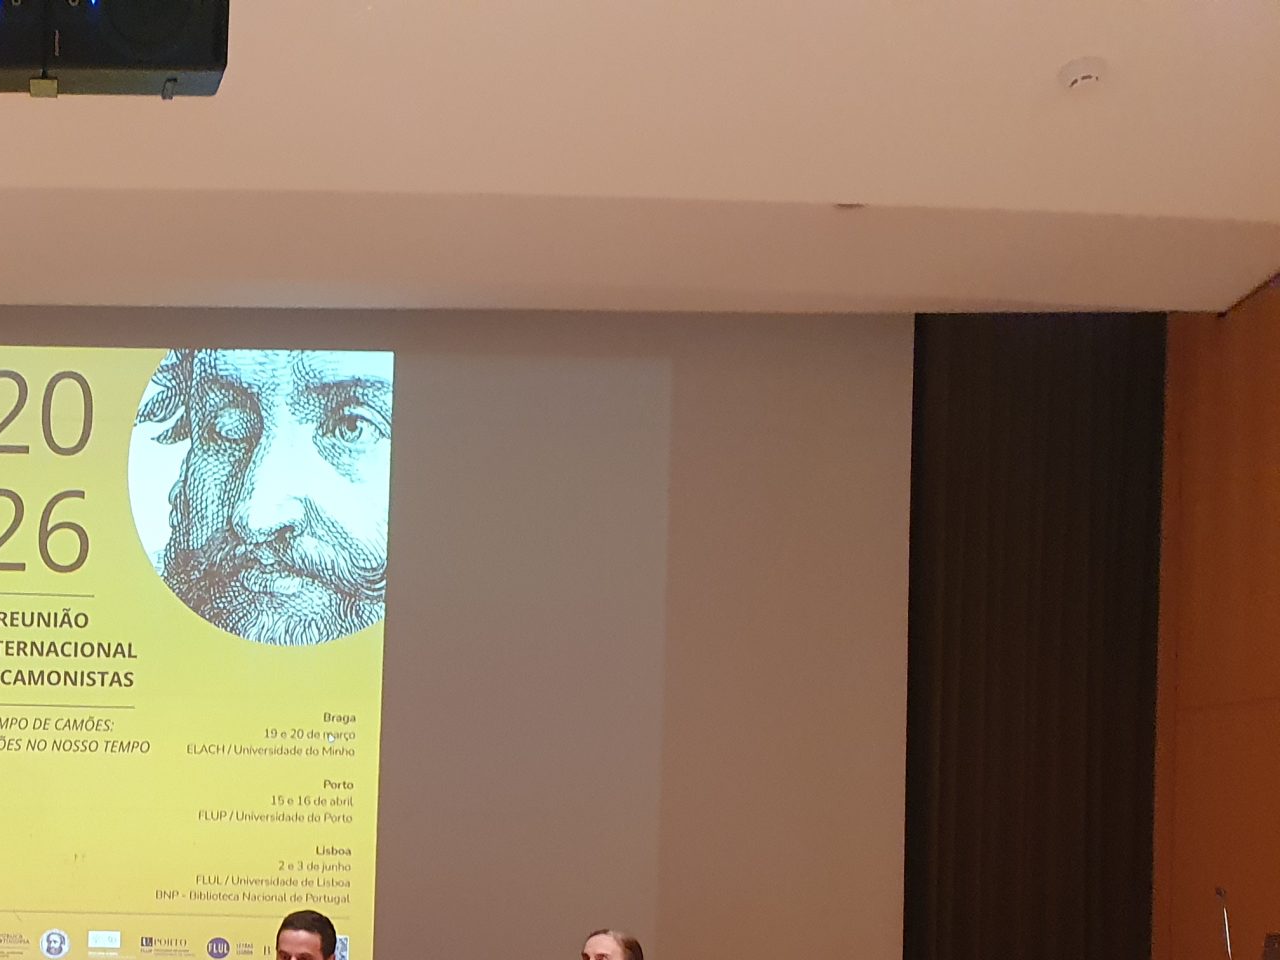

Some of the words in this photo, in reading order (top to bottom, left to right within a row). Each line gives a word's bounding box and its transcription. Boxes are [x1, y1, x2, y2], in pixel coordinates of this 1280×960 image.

[0, 669, 135, 688] CAMONISTAS
[32, 718, 51, 731] DE
[54, 716, 115, 733] CAMÕES:
[323, 712, 357, 725] Braga
[264, 728, 278, 739] 19
[281, 731, 288, 740] e
[291, 729, 304, 740] 20
[306, 729, 321, 741] de
[323, 731, 356, 742] março
[26, 738, 48, 752] NO
[51, 739, 99, 753] NOSSO
[104, 740, 151, 754] TEMPO
[186, 744, 225, 755] ELACH
[234, 744, 303, 757] Universidade
[305, 745, 319, 757] do
[322, 746, 356, 757] Minho
[323, 779, 354, 790] Porto
[271, 795, 285, 806] 15
[287, 798, 294, 806] e
[297, 795, 312, 806] 16
[313, 795, 327, 807] de
[330, 796, 354, 807] abril
[198, 810, 228, 821] FLUP
[235, 810, 305, 823] Universidade
[307, 811, 321, 823] do
[323, 812, 353, 824] Porto
[315, 845, 352, 857] Lisboa
[278, 860, 286, 871] 2
[288, 863, 295, 872] e
[297, 861, 304, 871] 3
[306, 861, 320, 872] de
[321, 861, 352, 874] junho
[196, 875, 223, 886] FLUL
[231, 875, 299, 888] Universidade
[301, 876, 315, 888] de
[316, 877, 351, 888] Lisboa
[155, 889, 180, 901] BNP
[189, 890, 240, 902] Biblioteca
[242, 891, 288, 903] Nacional
[290, 891, 304, 903] de
[305, 892, 350, 905] Portugal
[208, 941, 229, 954] FLUL
